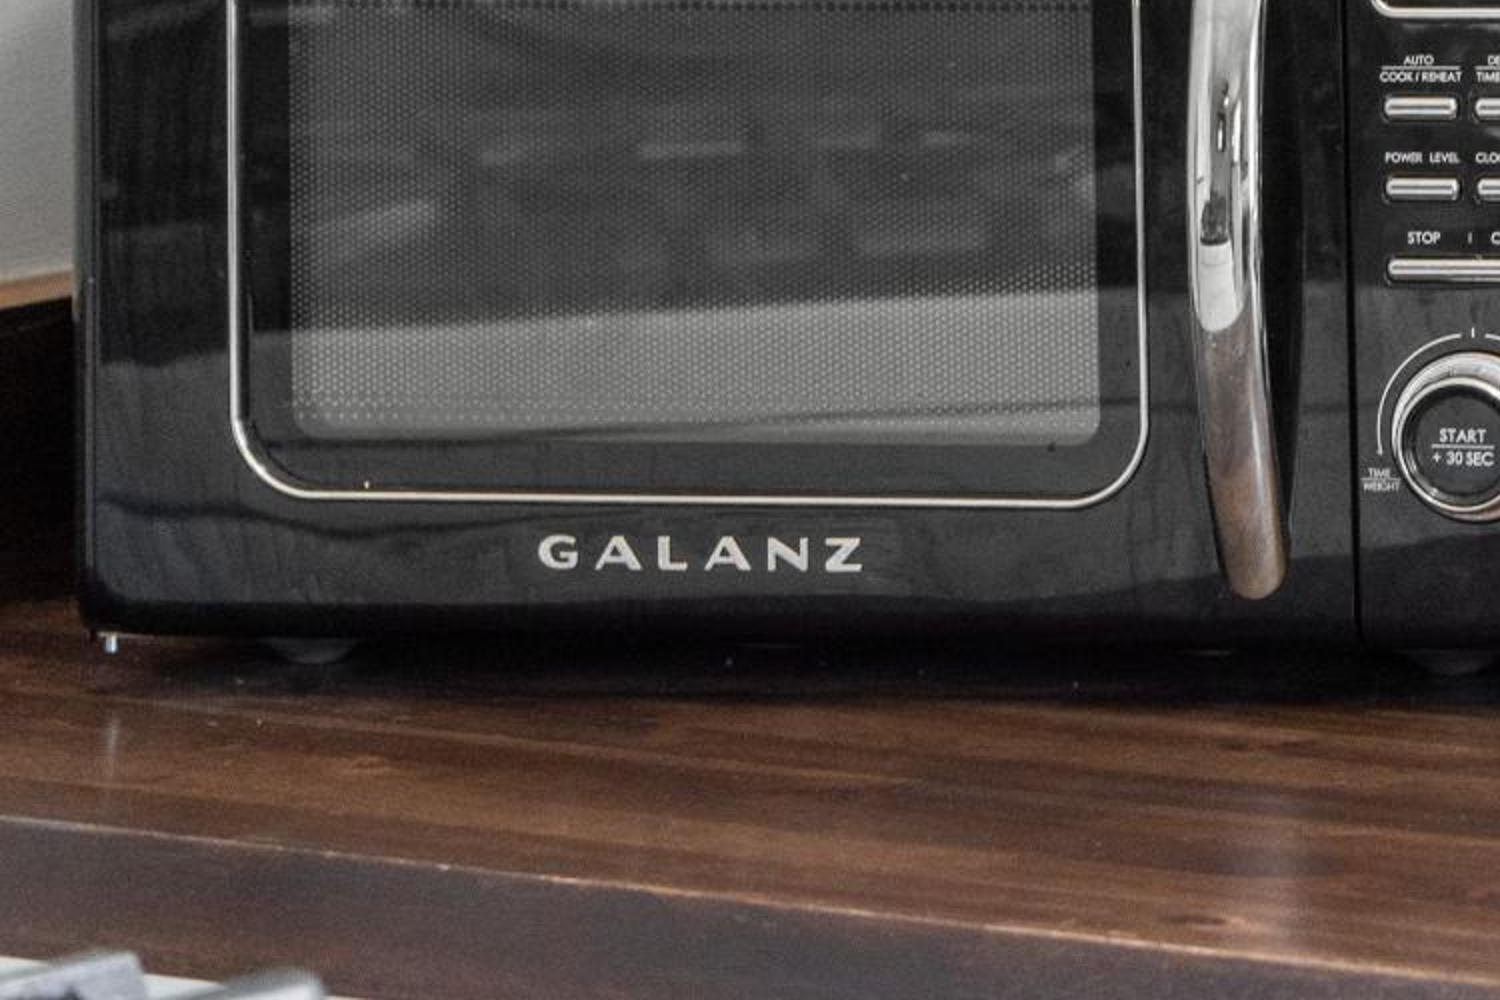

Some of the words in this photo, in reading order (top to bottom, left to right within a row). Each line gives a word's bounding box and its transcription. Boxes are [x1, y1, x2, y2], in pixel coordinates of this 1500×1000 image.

[1403, 54, 1435, 65] AUTO
[1379, 71, 1413, 83] COOK
[1476, 71, 1500, 83] TIME
[1385, 152, 1423, 164] POWER
[1429, 152, 1460, 164] LEVEL
[1407, 231, 1441, 245] STOP
[1439, 428, 1487, 443] START
[1446, 451, 1463, 466] 30
[1466, 451, 1495, 467] SEC
[1368, 467, 1391, 478] TIME
[538, 533, 863, 573] GALANZ
